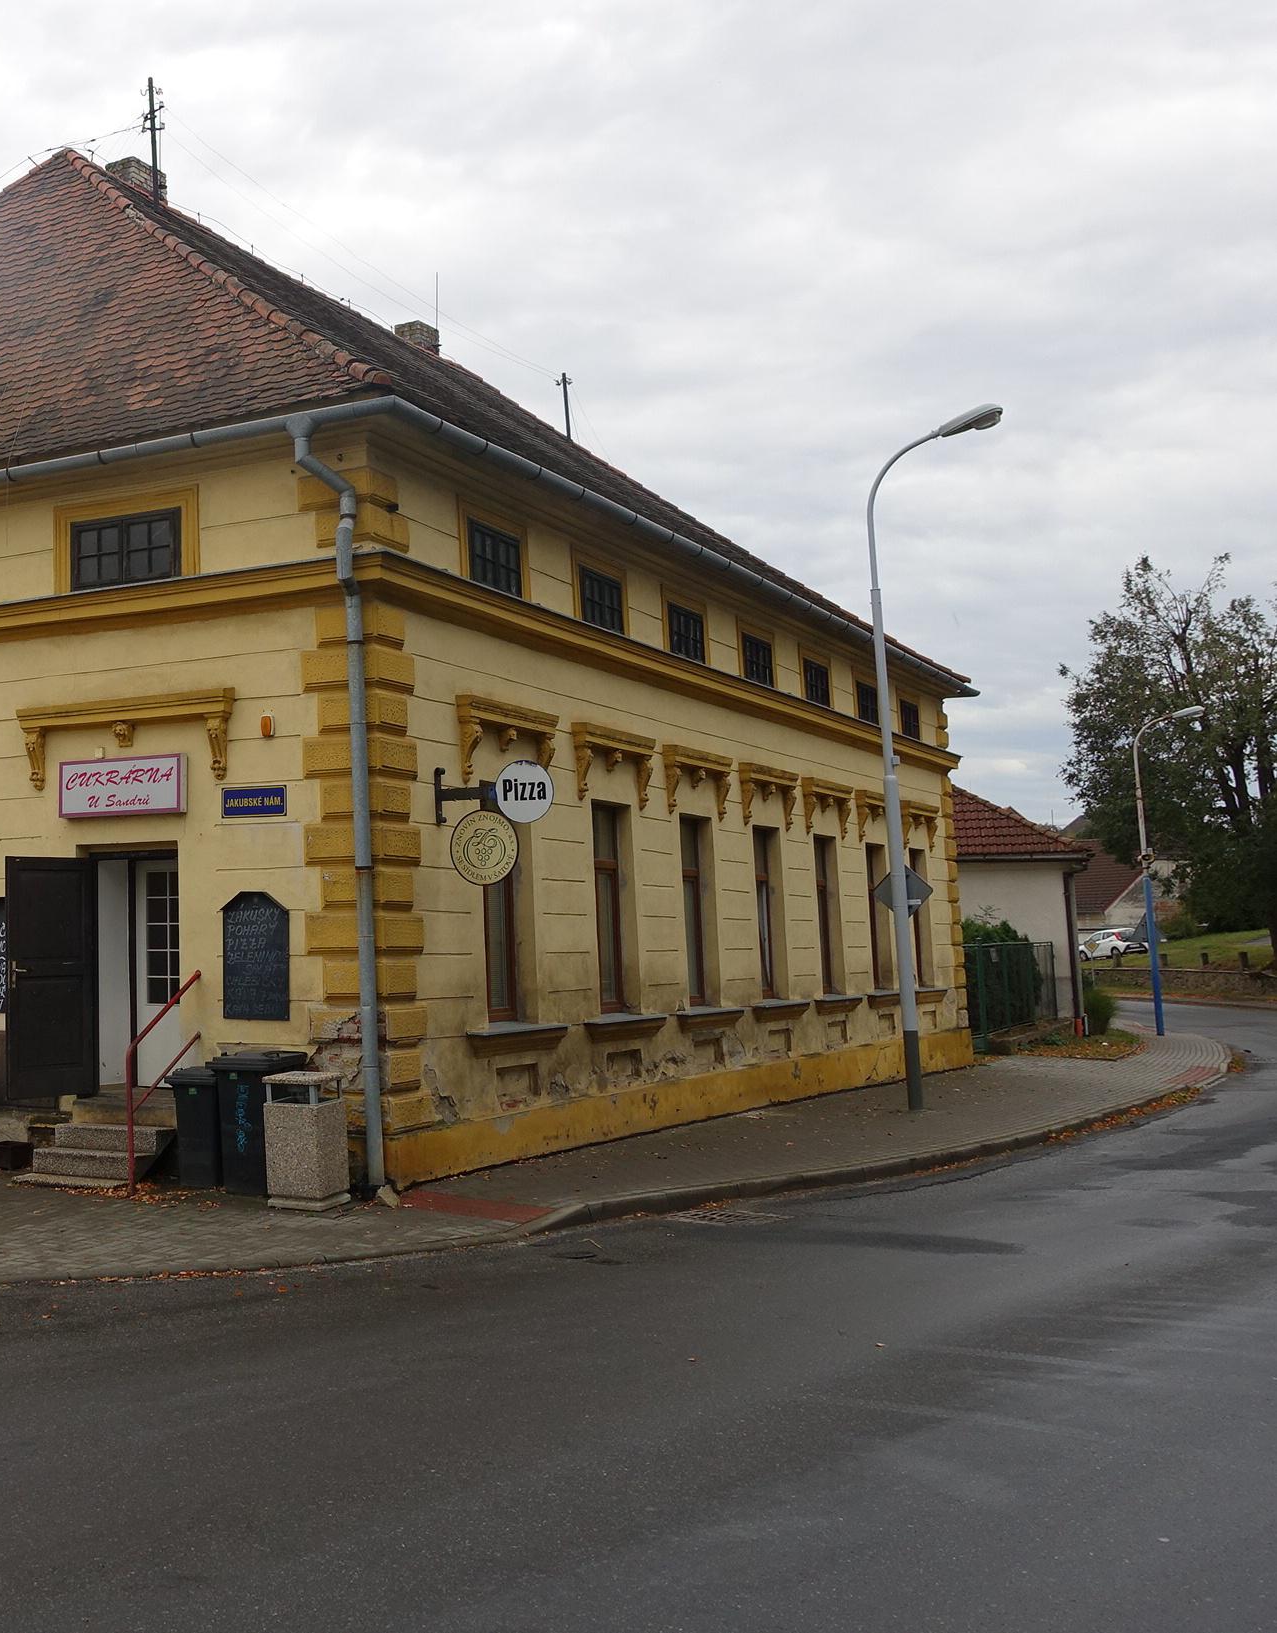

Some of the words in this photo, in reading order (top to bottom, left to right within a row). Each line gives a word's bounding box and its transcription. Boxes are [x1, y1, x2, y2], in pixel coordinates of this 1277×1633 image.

[65, 764, 174, 791] CUKRÁRNA
[502, 778, 547, 802] Pizza
[87, 795, 100, 808] U
[225, 796, 263, 808] JAKUBSKÉ
[264, 795, 283, 806] NÁM.
[226, 937, 266, 951] PIZZA
